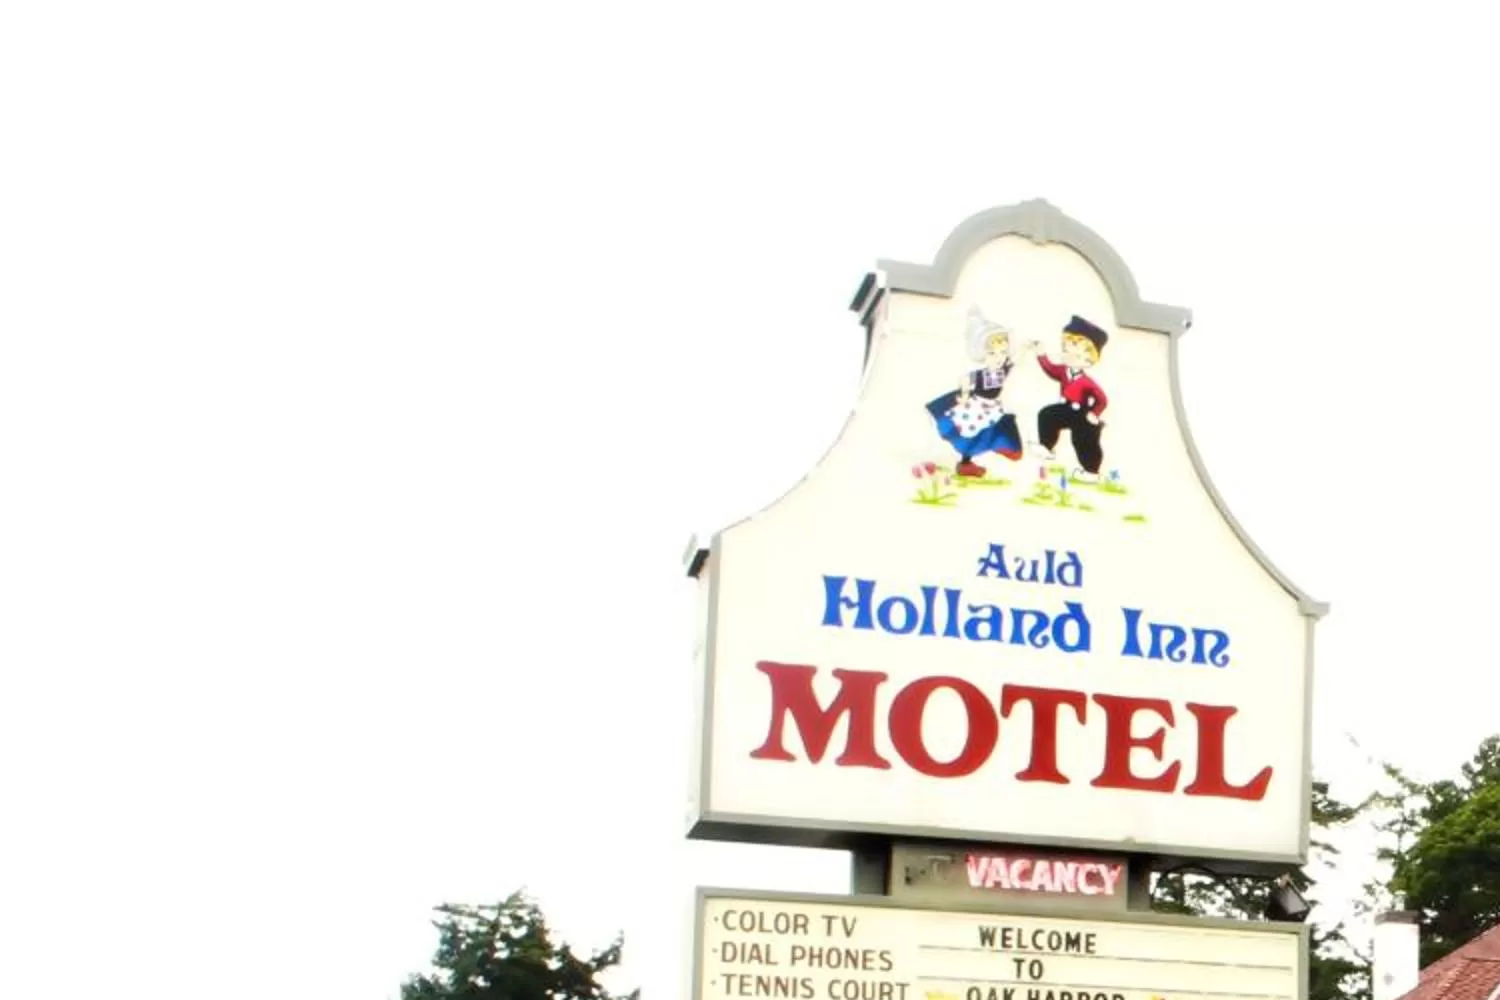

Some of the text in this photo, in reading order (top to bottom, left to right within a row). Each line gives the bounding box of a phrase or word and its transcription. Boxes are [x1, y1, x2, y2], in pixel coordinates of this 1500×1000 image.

[978, 543, 1083, 588] Auld
[820, 575, 1231, 668] Holland Inn
[750, 660, 1274, 801] MOTEL
[965, 853, 1122, 896] VACANCY
[722, 909, 858, 938] COLOR TV
[978, 925, 1097, 955] WELCOME
[720, 941, 894, 972] DIAL PHONES
[1012, 957, 1045, 981] TO
[721, 973, 815, 1000] TENNIS
